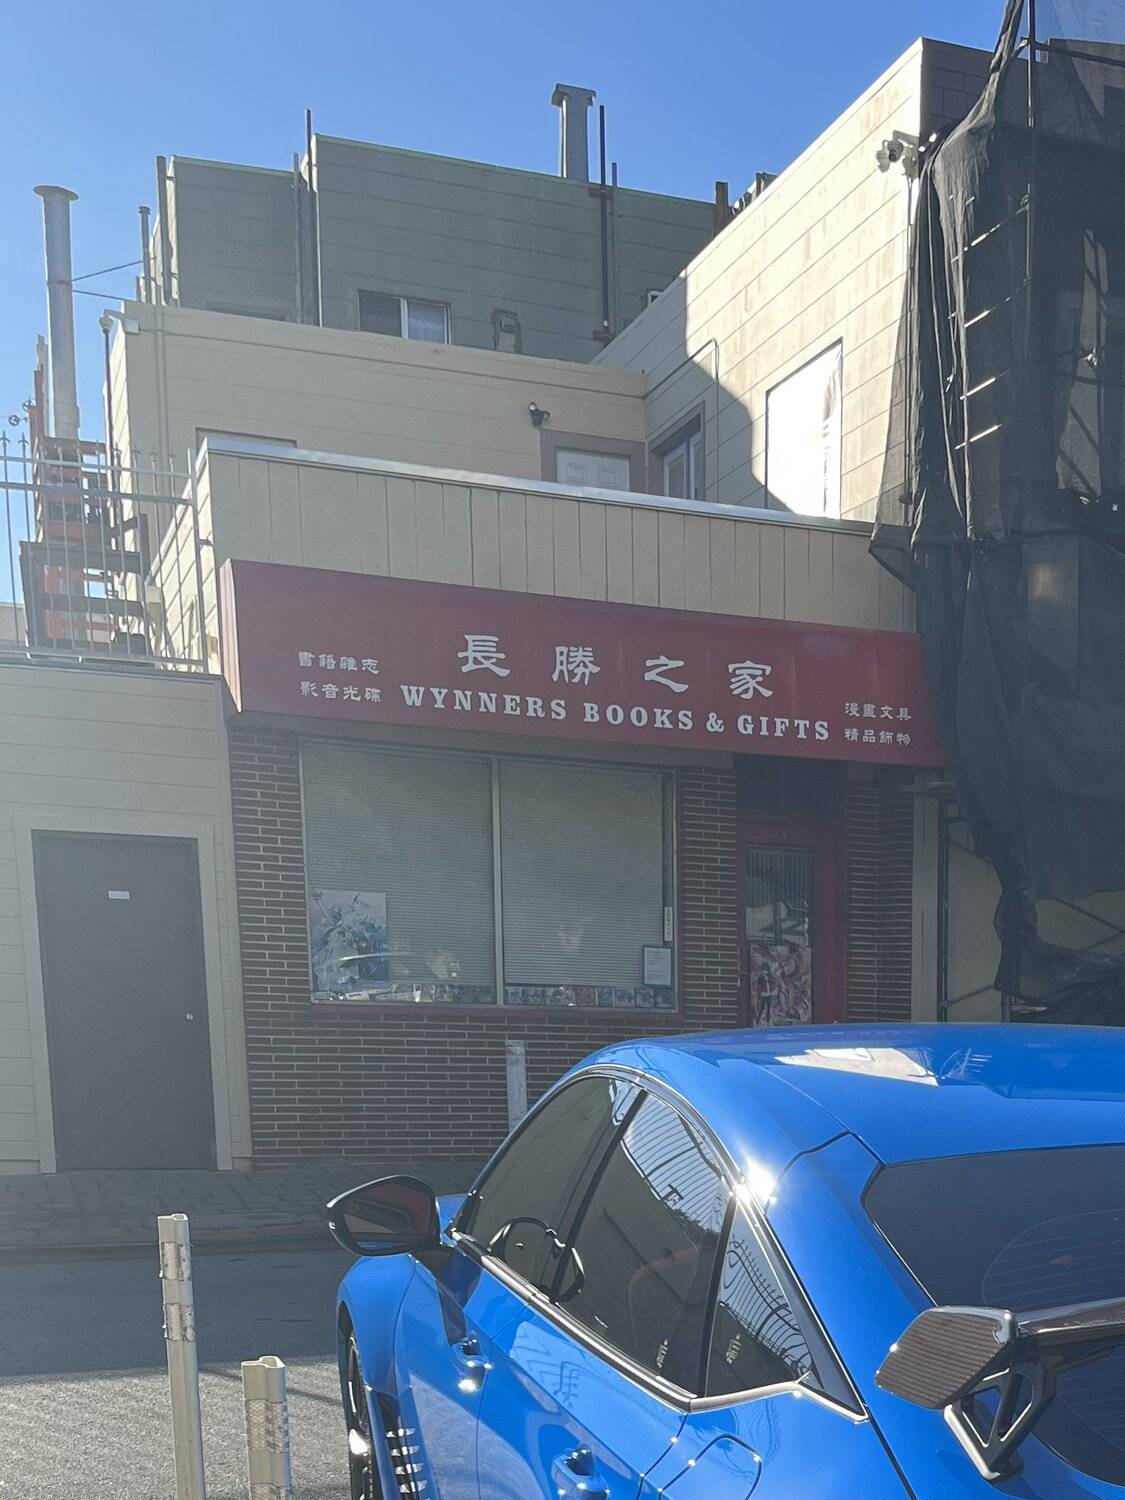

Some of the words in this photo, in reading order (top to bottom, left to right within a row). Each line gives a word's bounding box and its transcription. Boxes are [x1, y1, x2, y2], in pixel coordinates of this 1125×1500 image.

[457, 634, 774, 699] 長勝之家
[300, 681, 382, 703] 影音光碟
[400, 685, 567, 720] WYNNERS
[583, 702, 693, 731] BOOKS
[705, 712, 725, 733] &
[737, 714, 829, 741] GIFTS
[844, 702, 912, 721] 漫畫文具
[844, 728, 912, 746] 精品飾物
